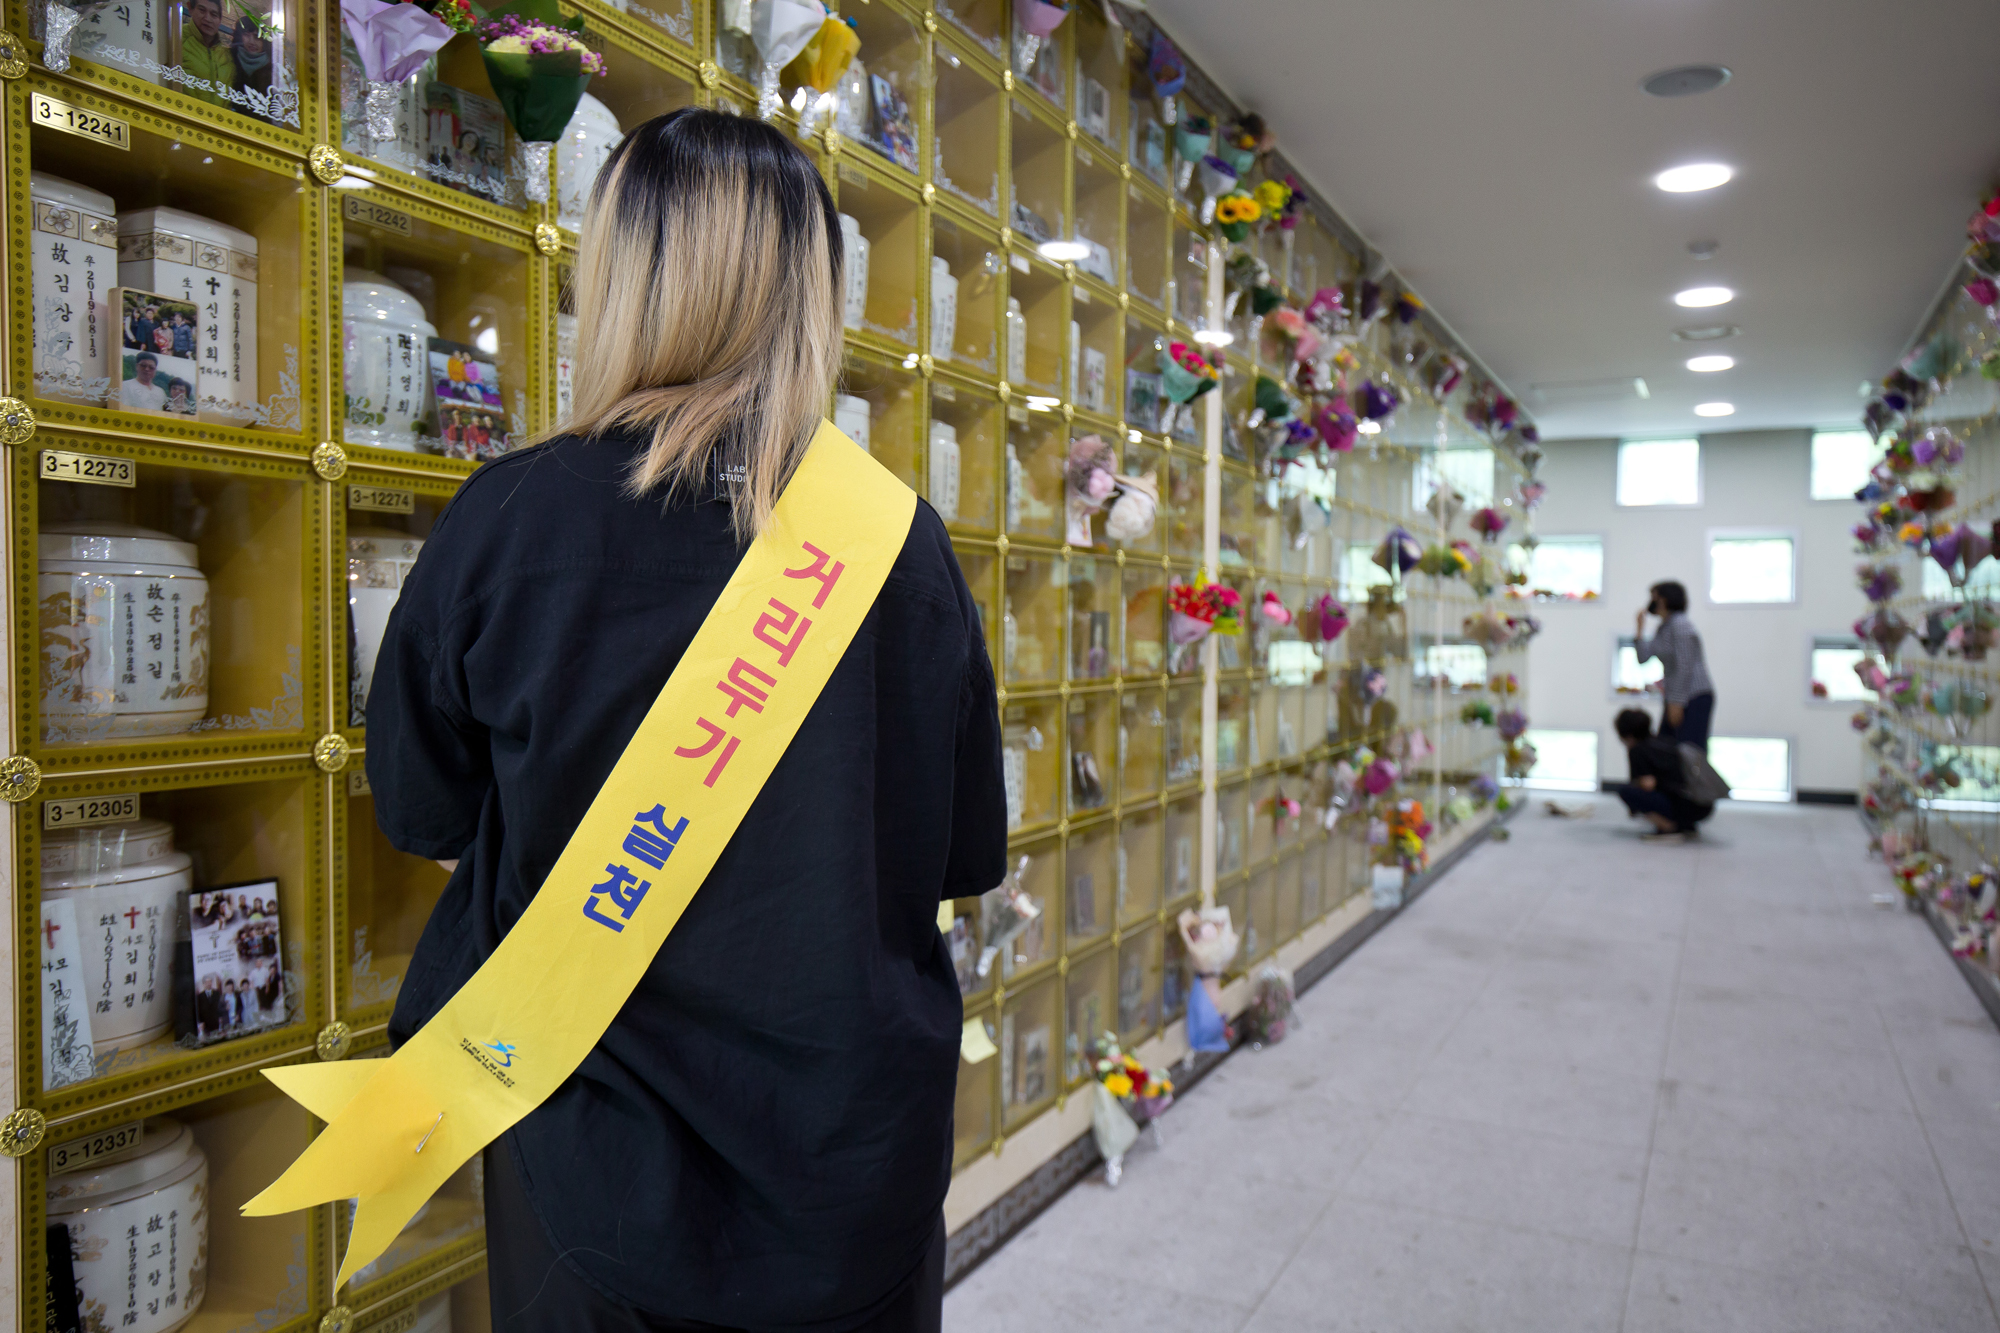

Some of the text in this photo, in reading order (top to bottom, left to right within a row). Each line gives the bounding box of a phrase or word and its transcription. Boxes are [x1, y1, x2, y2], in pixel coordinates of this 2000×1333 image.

[40, 101, 122, 141] 3-12241
[350, 201, 408, 230] 3-12242
[46, 455, 129, 479] 3-12273
[720, 473, 746, 482] STUDI
[728, 465, 746, 473] LAB
[353, 489, 409, 507] 3-12274
[582, 540, 846, 934] 거리두기 실천
[51, 799, 133, 821] 3-12305
[56, 1127, 138, 1167] 3-12337
